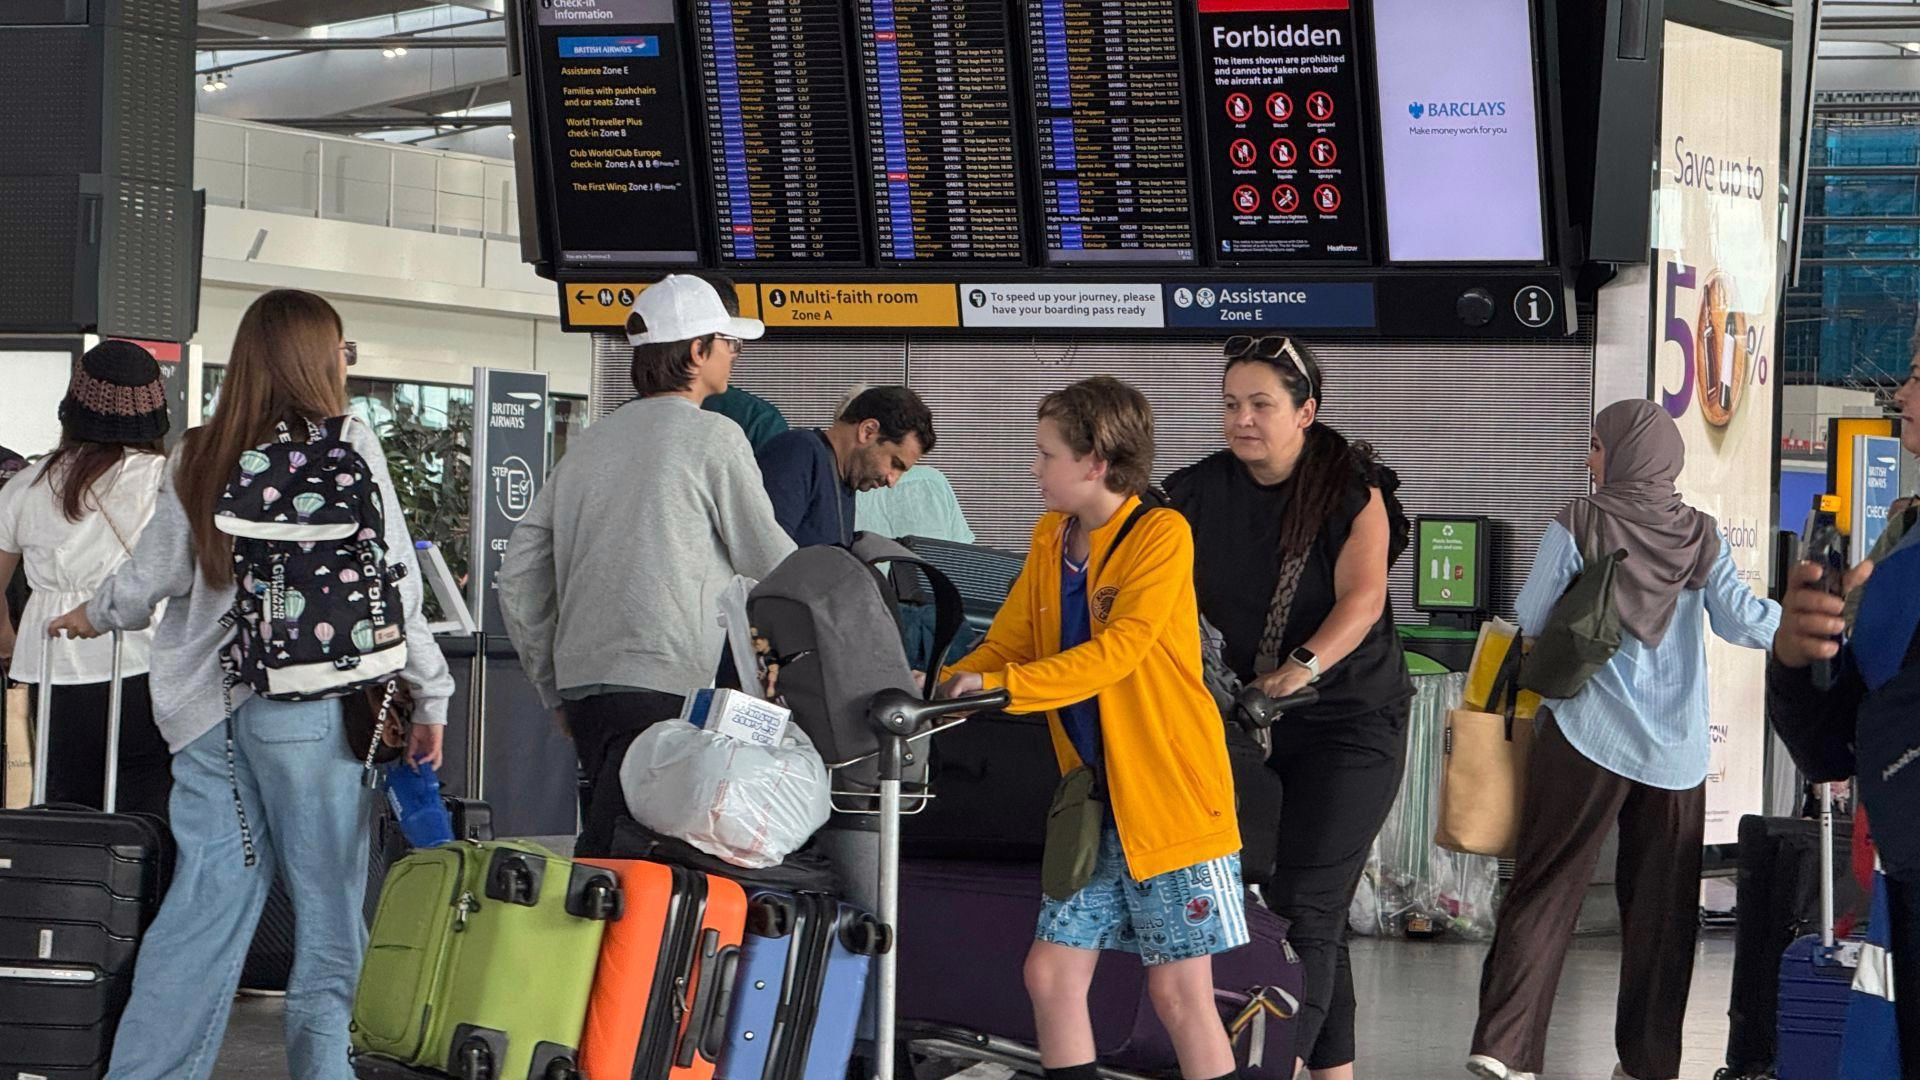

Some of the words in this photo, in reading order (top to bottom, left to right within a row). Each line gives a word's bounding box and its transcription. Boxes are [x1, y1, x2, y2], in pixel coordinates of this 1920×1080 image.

[555, 8, 614, 20] information
[1213, 24, 1342, 48] Forbidden
[574, 46, 602, 54] BRITISH
[602, 46, 634, 54] AIRWAYS
[1213, 56, 1229, 66] The
[1230, 56, 1254, 65] items
[1255, 56, 1284, 65] shown
[1300, 55, 1345, 66] prohibited
[602, 66, 622, 74] Zone
[624, 66, 629, 74] E
[1214, 67, 1230, 76] and
[1231, 67, 1261, 76] cannot
[1262, 66, 1273, 75] be
[1274, 66, 1298, 74] taken
[1312, 65, 1338, 74] board
[1215, 76, 1229, 86] the
[1230, 76, 1262, 85] aircraft
[1262, 76, 1272, 85] at
[1272, 76, 1284, 85] all
[563, 86, 594, 95] Families
[596, 86, 614, 94] with
[614, 86, 656, 96] pushchairs
[564, 98, 580, 106] and
[614, 98, 634, 106] Zone
[636, 97, 641, 106] E
[1428, 102, 1506, 117] BARCLAYS
[566, 118, 590, 126] World
[591, 118, 625, 126] Traveller
[626, 118, 643, 126] Plus
[567, 129, 600, 137] check-in
[600, 128, 620, 137] Zone
[621, 129, 626, 137] B
[1410, 127, 1430, 136] Make
[1431, 128, 1458, 137] money
[1458, 126, 1479, 135] work
[1480, 126, 1492, 134] for
[1492, 127, 1508, 137] you
[570, 149, 588, 158] Club
[588, 149, 632, 158] World/Club
[634, 148, 662, 159] Europe
[571, 160, 602, 168] check-in
[605, 160, 628, 168] Zones
[630, 160, 636, 168] A
[638, 160, 644, 168] &
[1674, 136, 1714, 191] Save
[1720, 160, 1742, 208] up
[1747, 156, 1764, 200] to
[573, 183, 589, 191] The
[588, 182, 606, 191] First
[606, 182, 628, 193] Wing
[628, 182, 648, 191] Zone
[1328, 244, 1358, 252] Heathrow
[790, 290, 872, 304] Multi-faith
[878, 293, 918, 304] room
[991, 292, 1004, 302] To
[1006, 292, 1035, 305] speed
[1038, 294, 1051, 305] up
[1054, 294, 1076, 305] your
[1079, 292, 1120, 306] journey,
[1124, 292, 1156, 305] please
[1219, 288, 1306, 304] Assistance
[792, 310, 820, 320] Zone
[824, 310, 832, 320] A
[992, 305, 1016, 314] have
[1018, 306, 1042, 316] your
[1045, 305, 1090, 316] boarding
[1093, 306, 1114, 316] pass
[1118, 304, 1146, 316] ready
[1220, 310, 1252, 320] Zone
[1255, 310, 1262, 320] E
[492, 402, 524, 416] BRITISH
[490, 416, 525, 429] AIRWAYS
[492, 466, 508, 477] STEP
[496, 478, 500, 492] 1
[1867, 505, 1888, 518] CHECK-
[492, 540, 508, 550] GET
